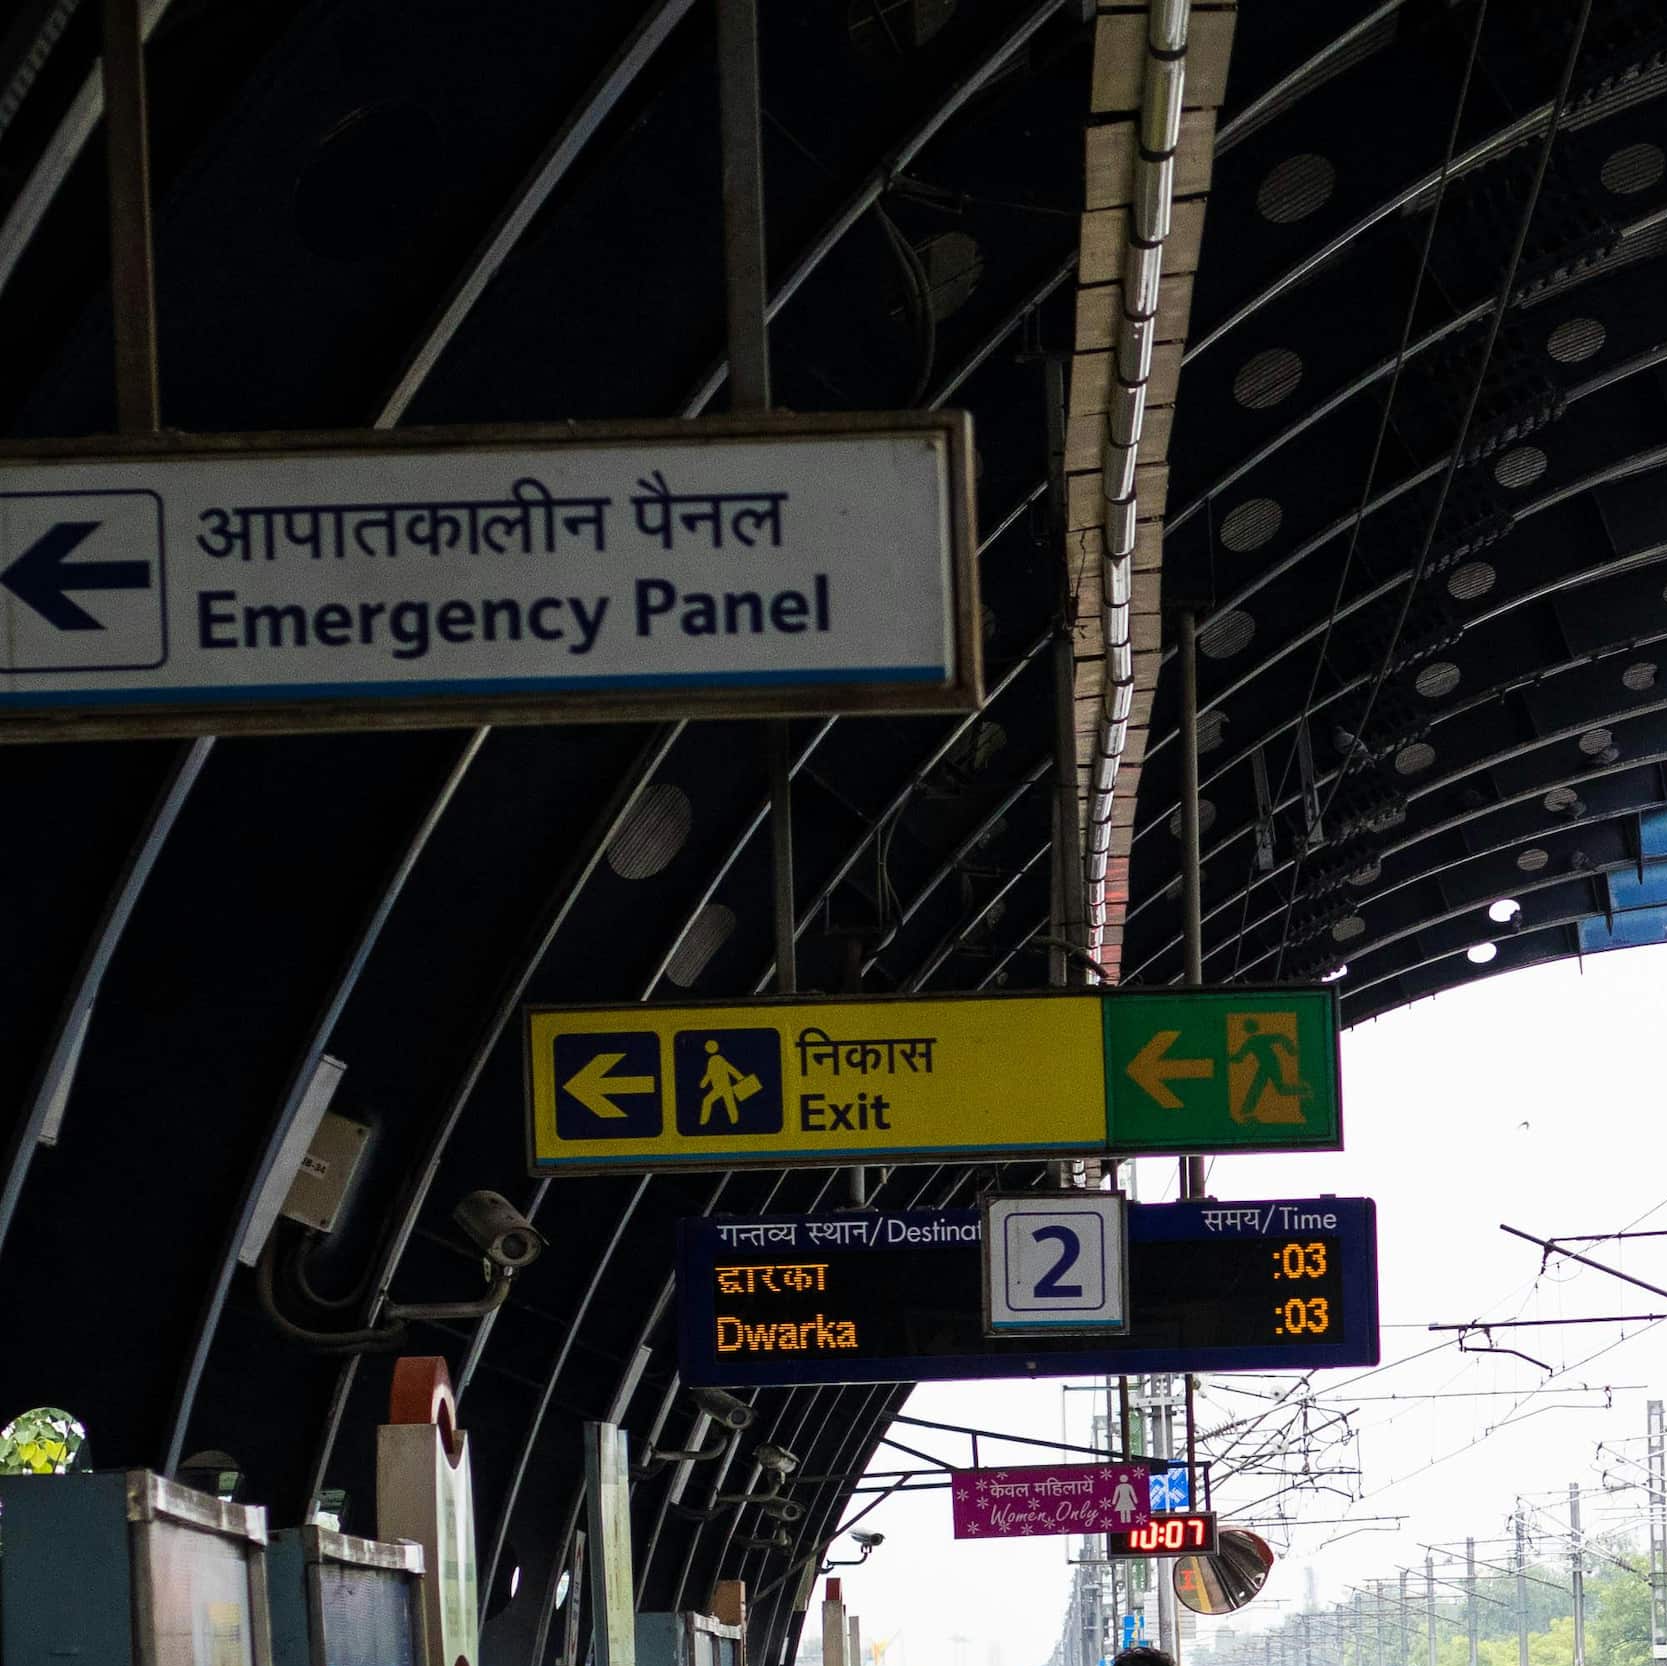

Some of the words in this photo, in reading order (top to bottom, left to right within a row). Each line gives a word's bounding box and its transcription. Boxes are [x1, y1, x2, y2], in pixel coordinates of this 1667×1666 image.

[197, 476, 611, 561] आपातकालीन
[631, 471, 788, 549] पैनल
[200, 590, 609, 659] Emergency
[634, 575, 830, 637] Panel
[795, 1027, 937, 1076] निकास
[800, 1092, 892, 1132] Exit
[717, 1223, 797, 1247] गन्तव्य
[805, 1217, 981, 1247] स्थान/Destinat
[1031, 1225, 1083, 1298] 2
[1272, 1242, 1327, 1280] :03
[717, 1313, 859, 1351] Dwarka
[1274, 1297, 1329, 1335] :03
[990, 1480, 1030, 1499] केवल
[1033, 1475, 1095, 1497] महिलायें
[991, 1503, 1047, 1526] Women
[1055, 1500, 1100, 1528] Only
[1130, 1520, 1205, 1550] 10:07
